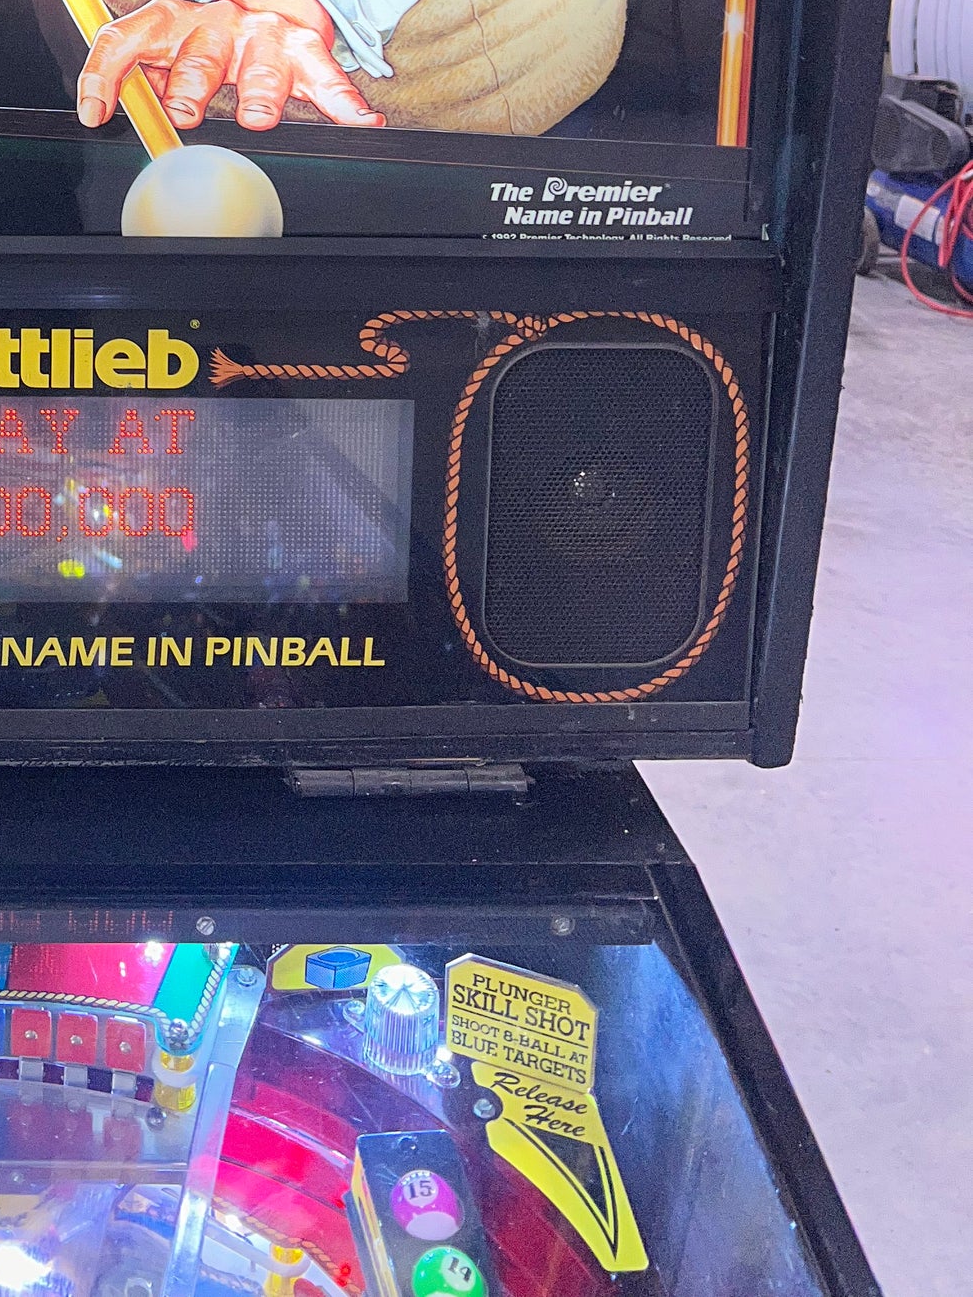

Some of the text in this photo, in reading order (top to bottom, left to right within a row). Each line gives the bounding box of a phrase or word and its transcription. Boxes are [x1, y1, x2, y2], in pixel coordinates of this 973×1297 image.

[490, 176, 663, 202] The Premier
[503, 206, 693, 226] Name in Pinball
[629, 233, 643, 241] All
[107, 408, 196, 454] AT
[1, 637, 135, 667] NAME
[146, 637, 193, 667] IN
[205, 637, 386, 667] PINBALL
[472, 973, 571, 1015] PLUNGER
[452, 983, 590, 1042] SKILL SHOT
[452, 1014, 588, 1065] SHOOT 8-BALL AT
[452, 1029, 587, 1085] BLUE TARGETS
[490, 1071, 588, 1115] Release
[523, 1104, 586, 1138] Here
[409, 1180, 432, 1200] 15
[447, 1256, 473, 1283] 14
